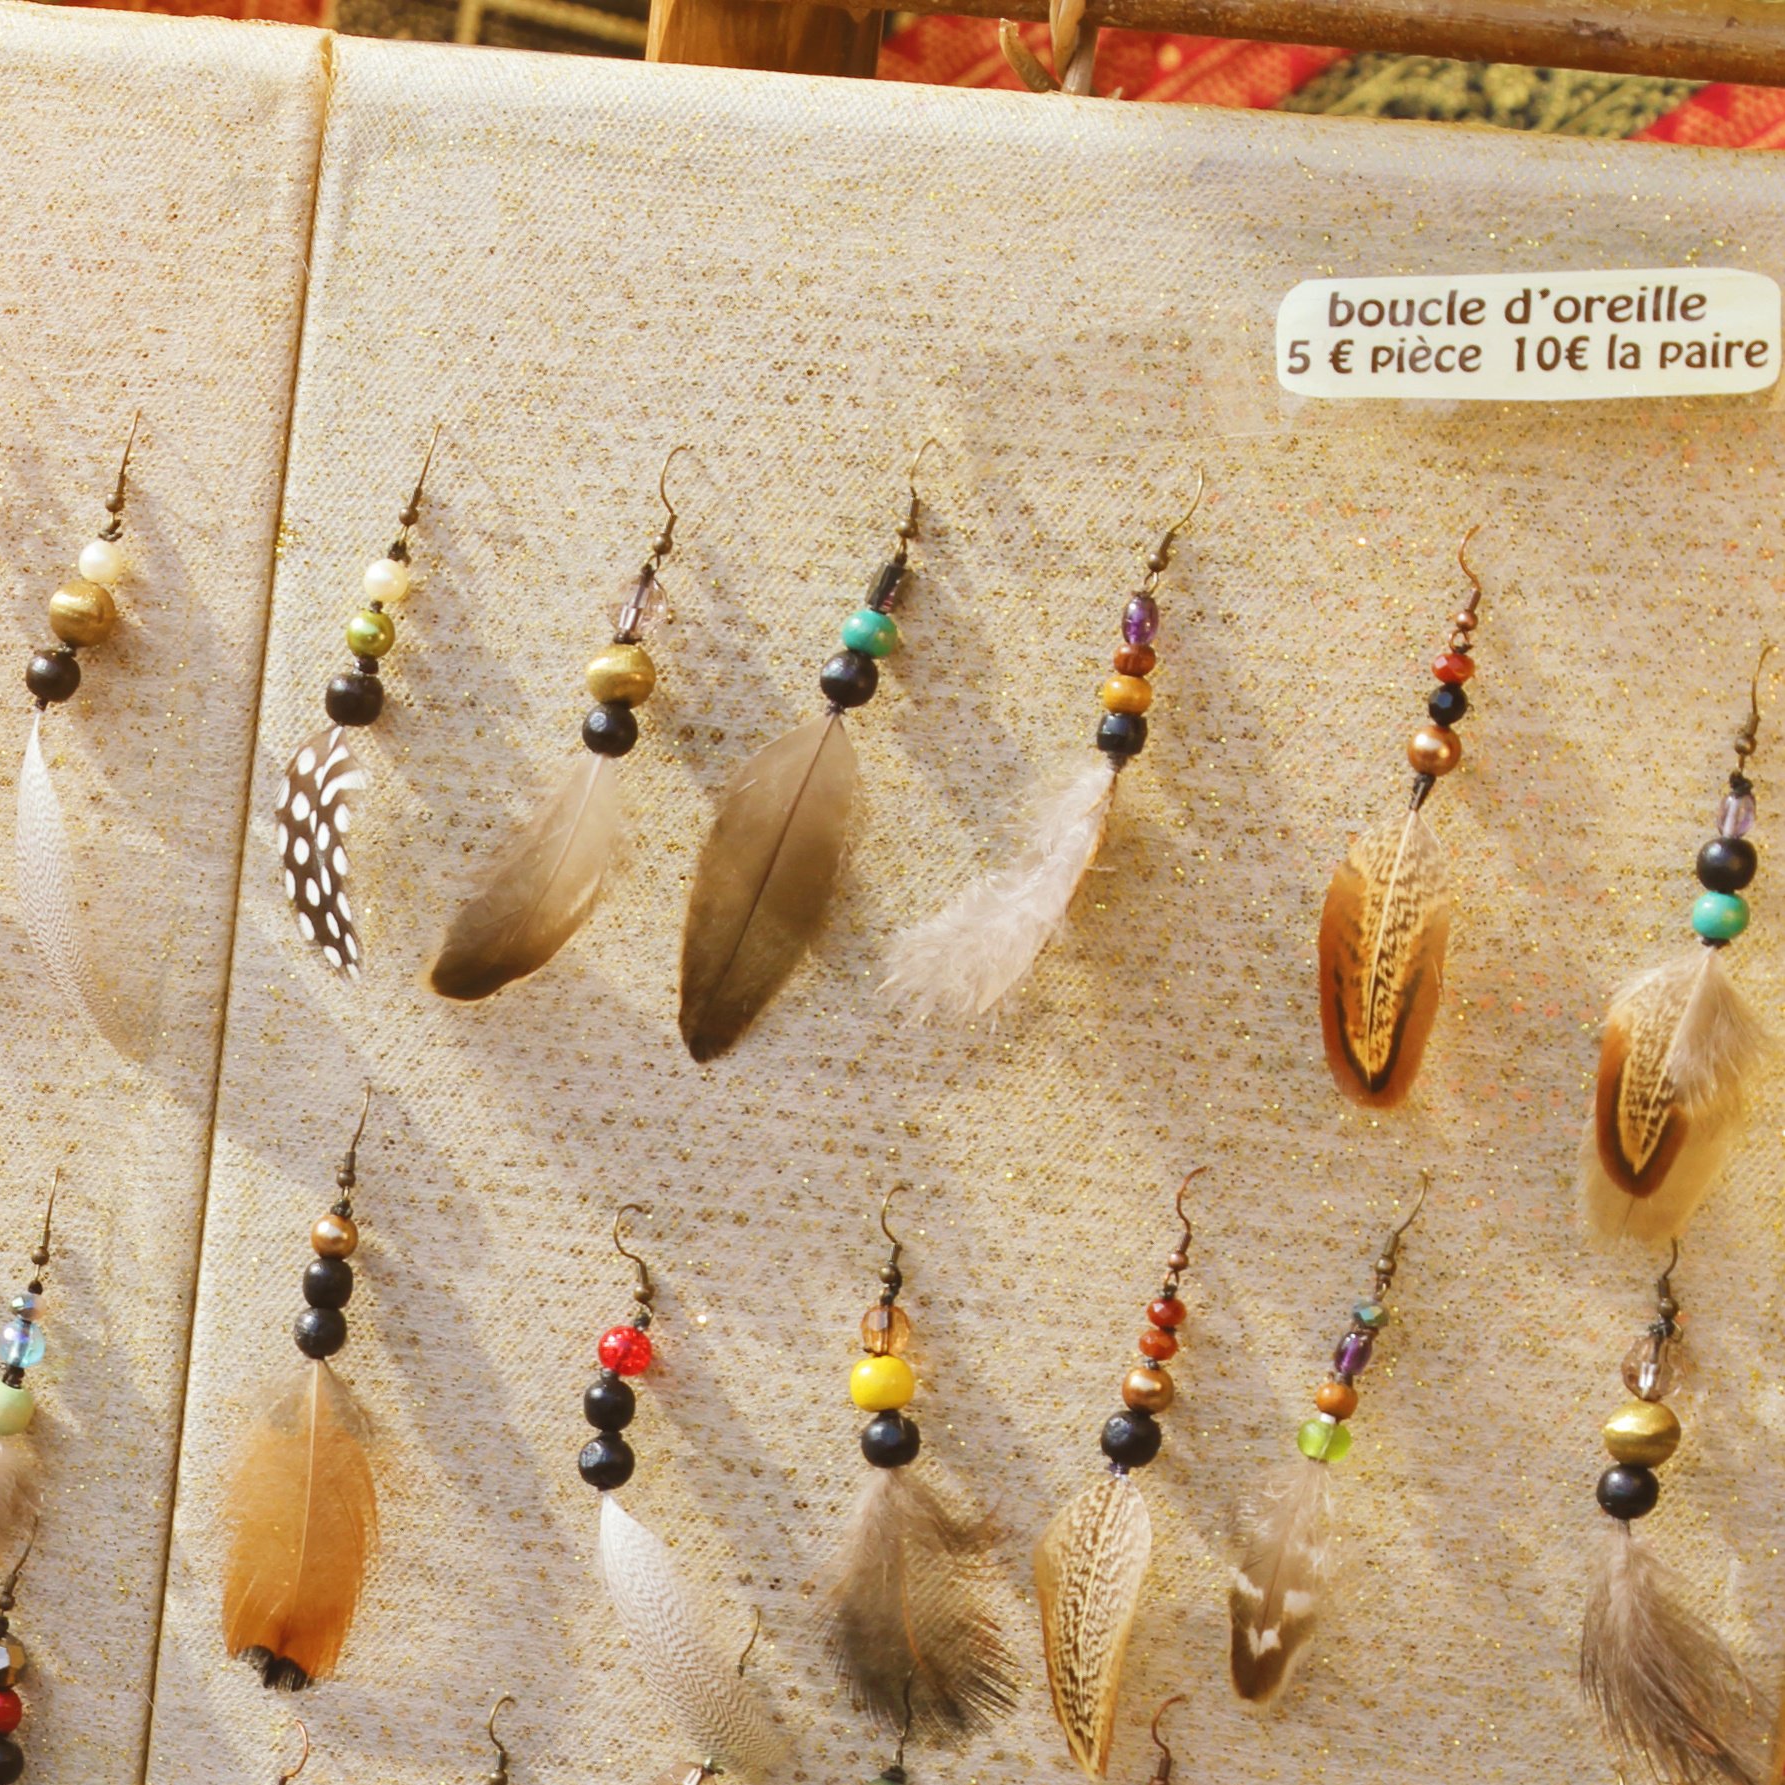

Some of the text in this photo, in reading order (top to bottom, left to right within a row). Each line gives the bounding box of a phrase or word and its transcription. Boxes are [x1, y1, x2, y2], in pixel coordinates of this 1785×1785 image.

[1328, 289, 1487, 328] boucle
[1287, 331, 1769, 375] 5 € pièce 10€ la paire
